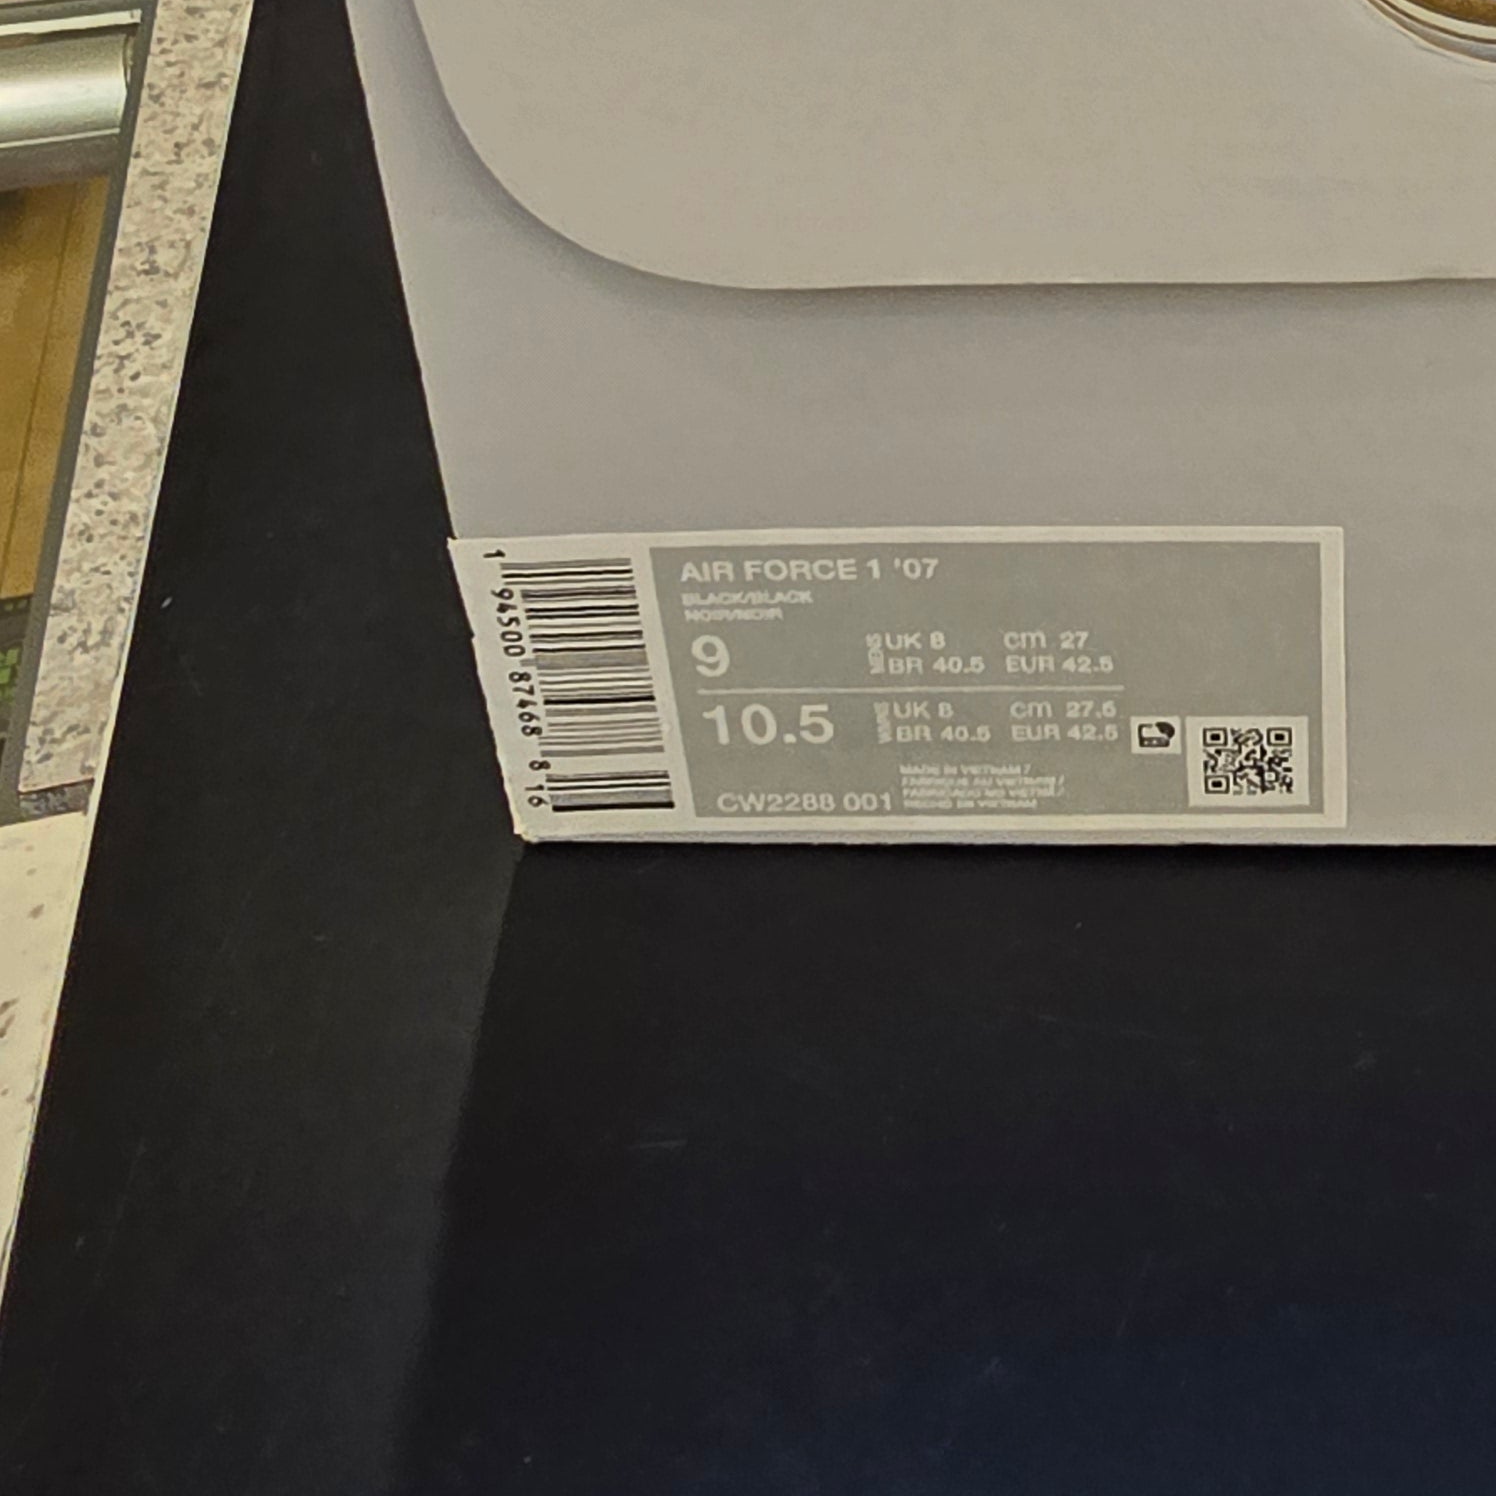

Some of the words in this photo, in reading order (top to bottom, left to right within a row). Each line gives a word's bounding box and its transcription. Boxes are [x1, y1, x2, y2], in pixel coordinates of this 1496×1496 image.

[680, 560, 734, 582] AIR
[744, 558, 858, 581] FORCE
[866, 558, 881, 579] 1
[894, 557, 939, 579] '07
[885, 632, 922, 650] UK
[1059, 631, 1089, 649] 27
[691, 635, 730, 677] 9
[889, 656, 923, 675] BR
[932, 656, 985, 674] 40.5
[1005, 655, 1055, 674] EUR
[893, 701, 931, 719] UK
[702, 703, 834, 745] 10.5
[896, 725, 932, 742] BR
[1011, 724, 1061, 742] EUR
[717, 792, 834, 812] CW2288
[843, 791, 891, 811] 001
